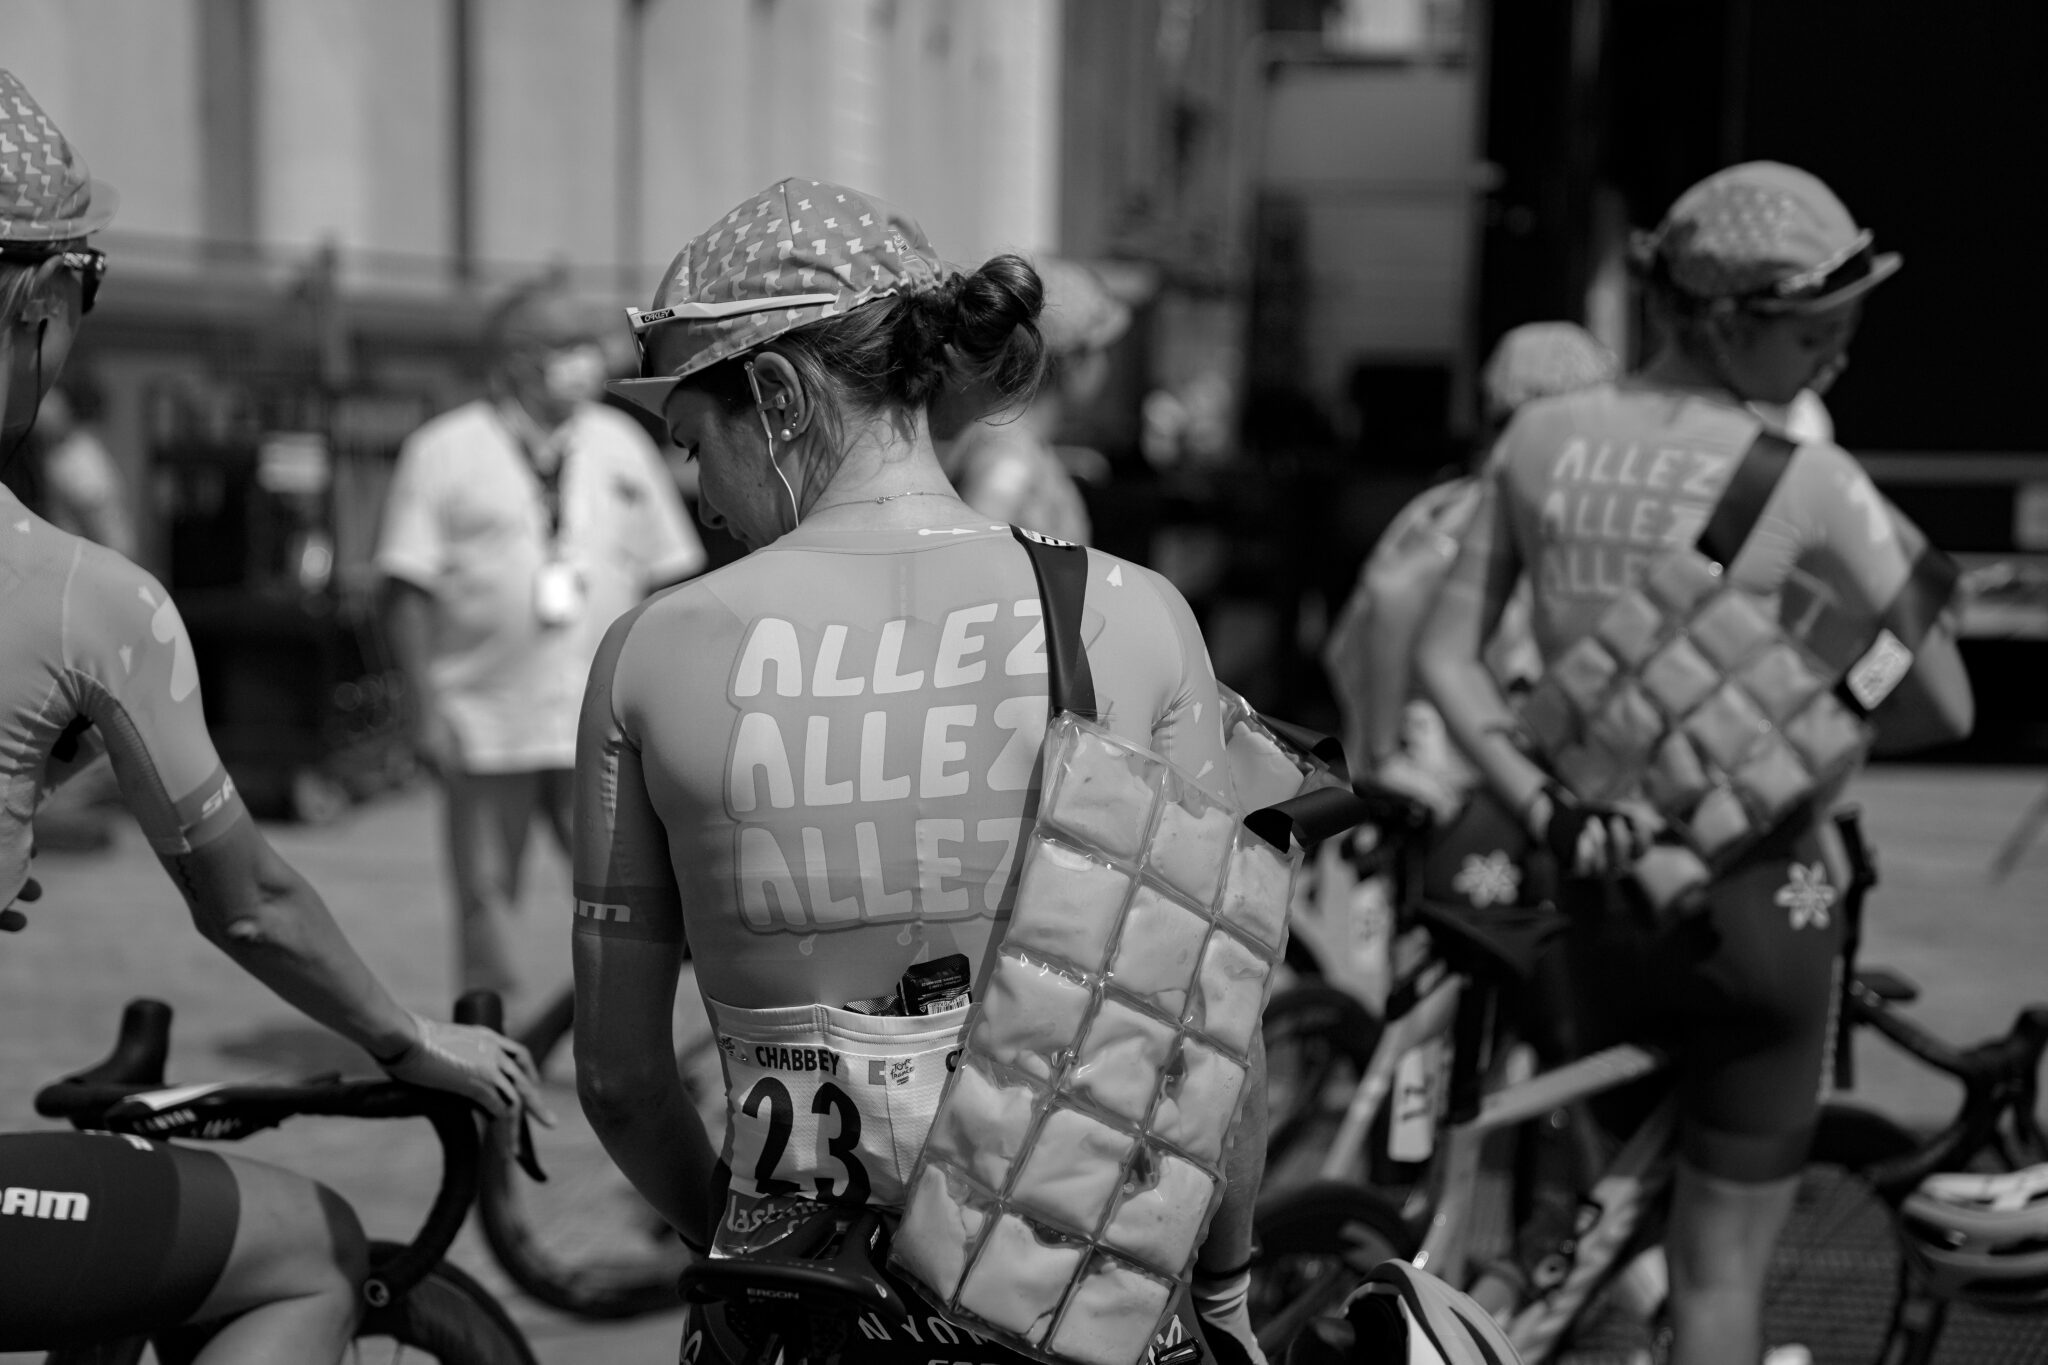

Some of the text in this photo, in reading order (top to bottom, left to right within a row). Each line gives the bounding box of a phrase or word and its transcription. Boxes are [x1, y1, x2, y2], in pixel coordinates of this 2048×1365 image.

[1552, 440, 1730, 495] ALLEZ
[755, 1045, 841, 1077] CHABBEY
[741, 1076, 872, 1205] 23
[0, 1186, 91, 1222] AM
[745, 1286, 800, 1301] ERGON
